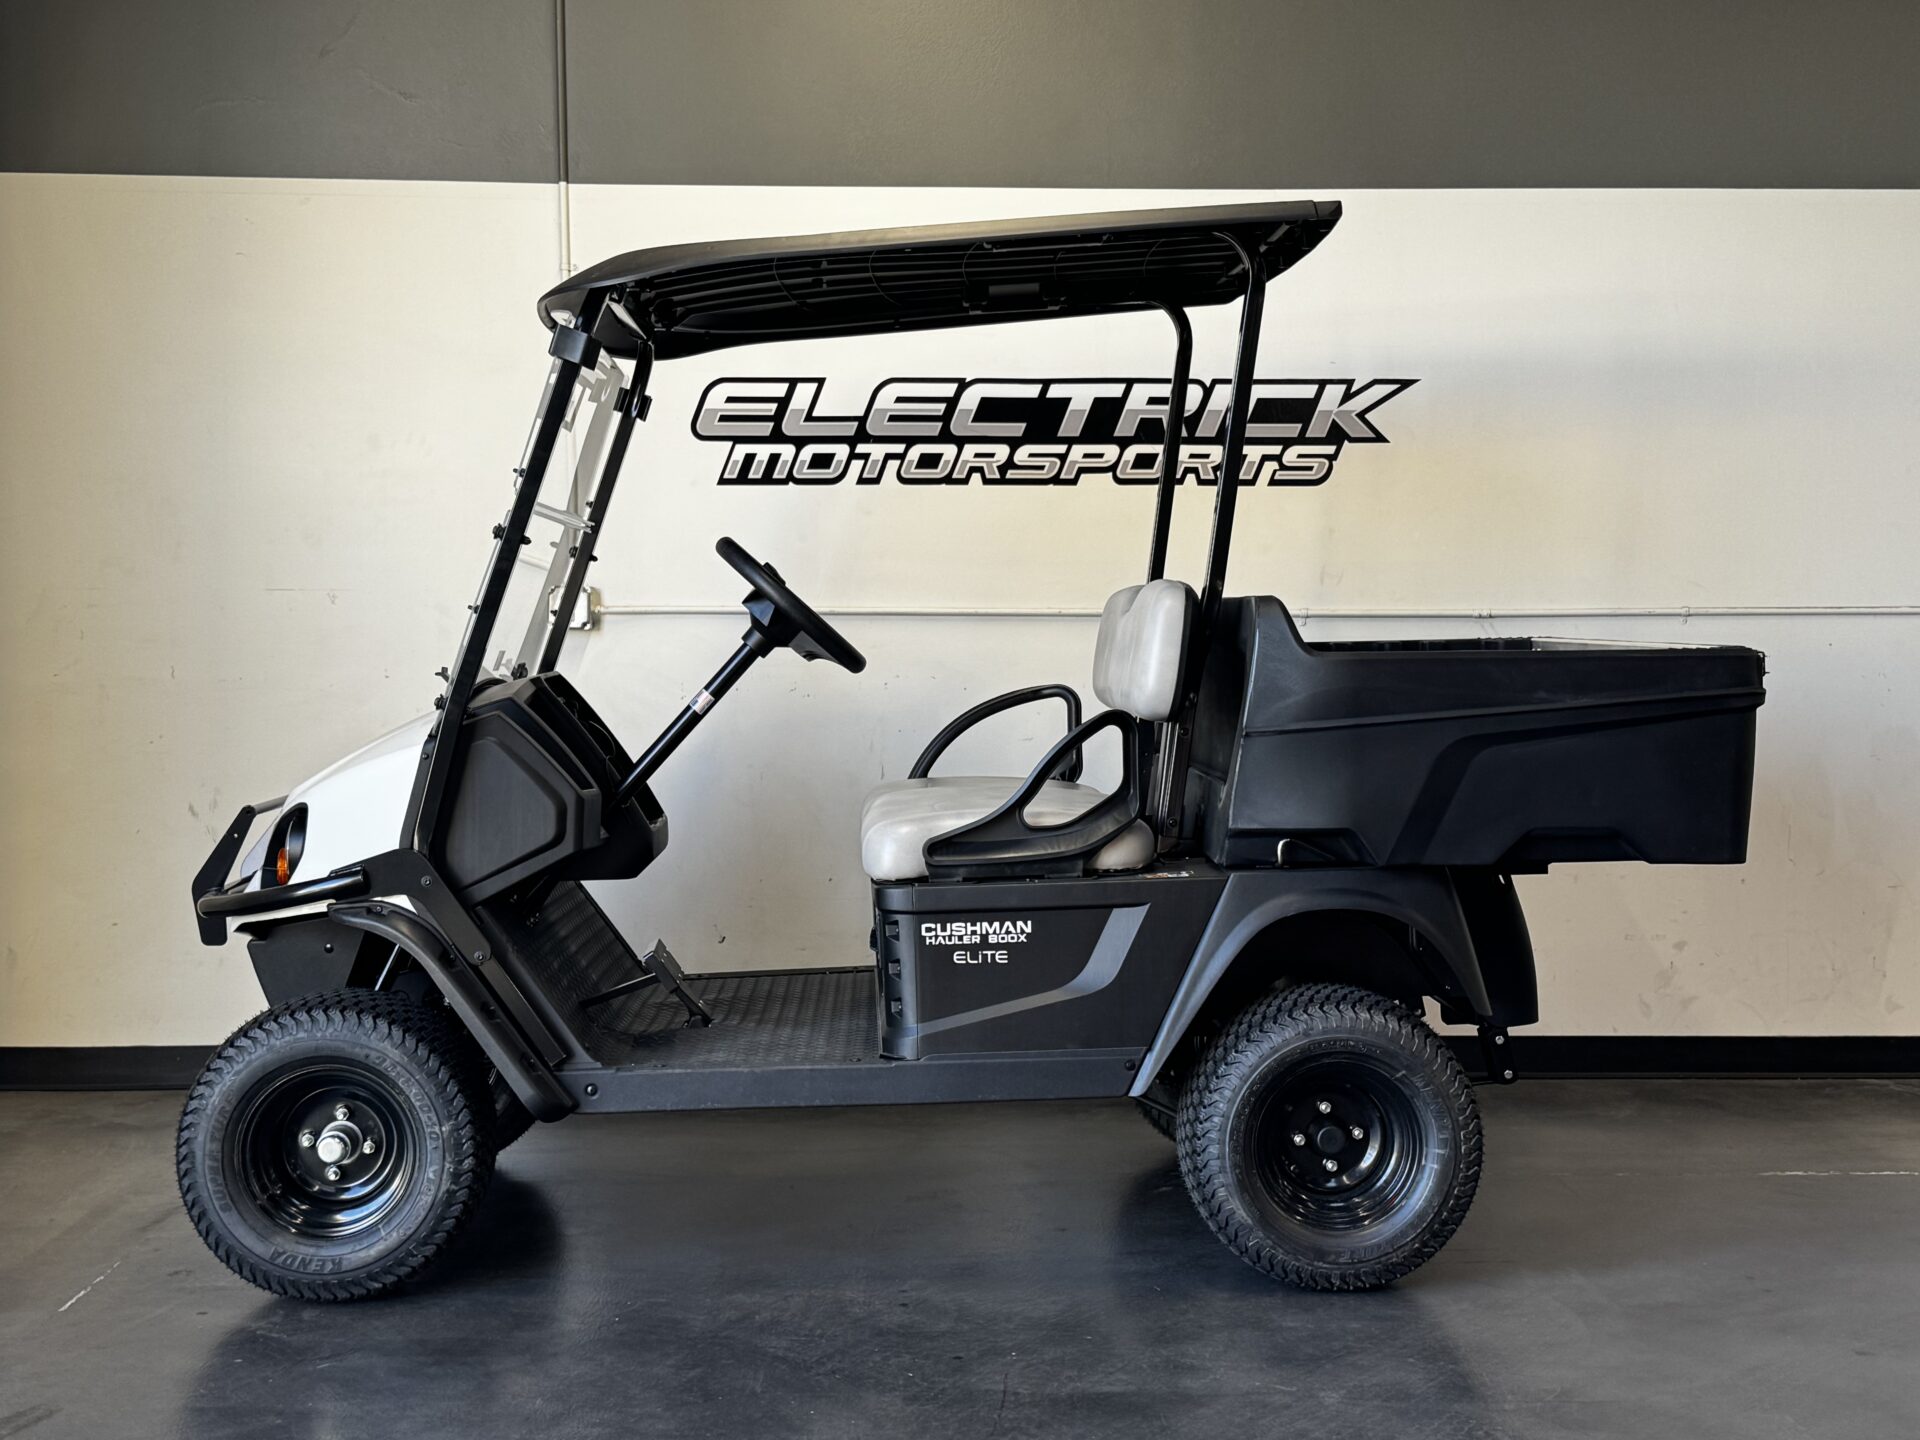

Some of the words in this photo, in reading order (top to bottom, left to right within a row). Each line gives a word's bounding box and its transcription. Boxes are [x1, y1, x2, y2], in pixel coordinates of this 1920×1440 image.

[692, 377, 1416, 441] ELECTRICK
[718, 441, 1342, 485] MOTORSPORTS
[921, 920, 1032, 936] CUSHMAN
[925, 935, 980, 945] HAULER
[988, 933, 1027, 943] 800X
[269, 1246, 345, 1274] KENDA
